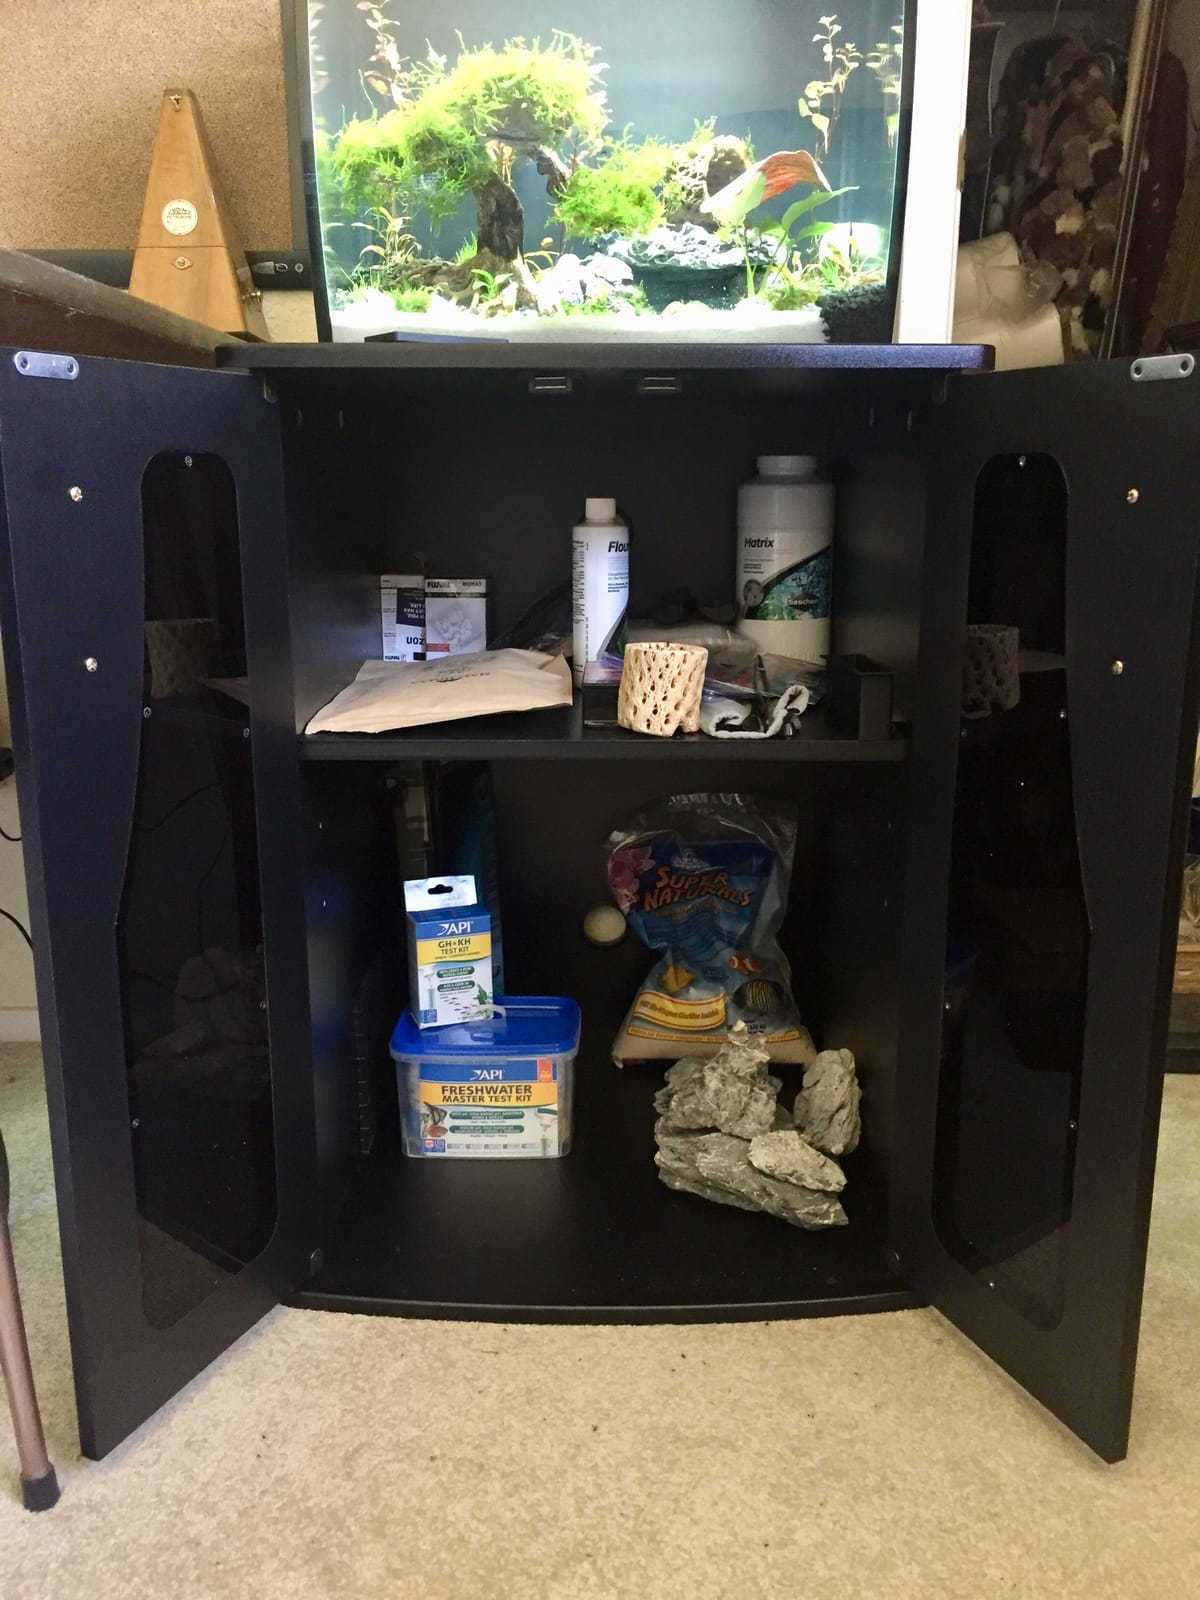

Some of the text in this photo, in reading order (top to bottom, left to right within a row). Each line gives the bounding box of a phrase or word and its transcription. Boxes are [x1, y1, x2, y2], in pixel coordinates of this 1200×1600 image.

[744, 537, 775, 548] Matrix
[446, 921, 471, 935] API
[438, 940, 452, 949] GH
[457, 938, 471, 946] KH
[441, 947, 457, 955] TEST
[479, 1070, 503, 1080] API
[441, 1085, 532, 1095] FRESHWATER
[442, 1095, 485, 1103] MASTER
[489, 1095, 512, 1103] TEST
